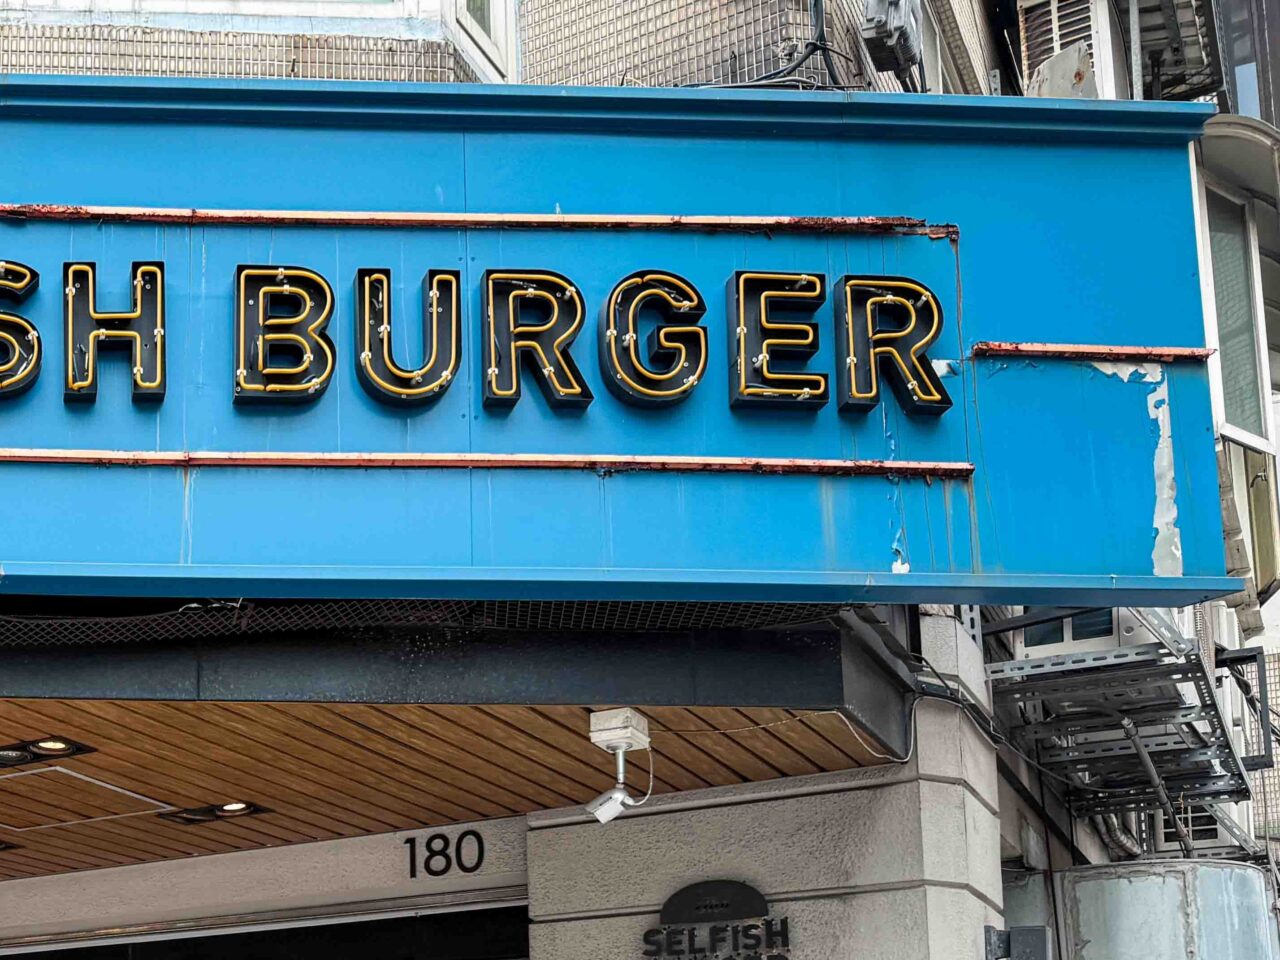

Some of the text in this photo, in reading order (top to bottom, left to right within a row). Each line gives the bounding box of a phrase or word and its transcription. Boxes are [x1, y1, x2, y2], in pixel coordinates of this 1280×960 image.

[233, 264, 953, 416] BURGER
[404, 830, 484, 878] 180
[643, 917, 790, 956] SELFISH
